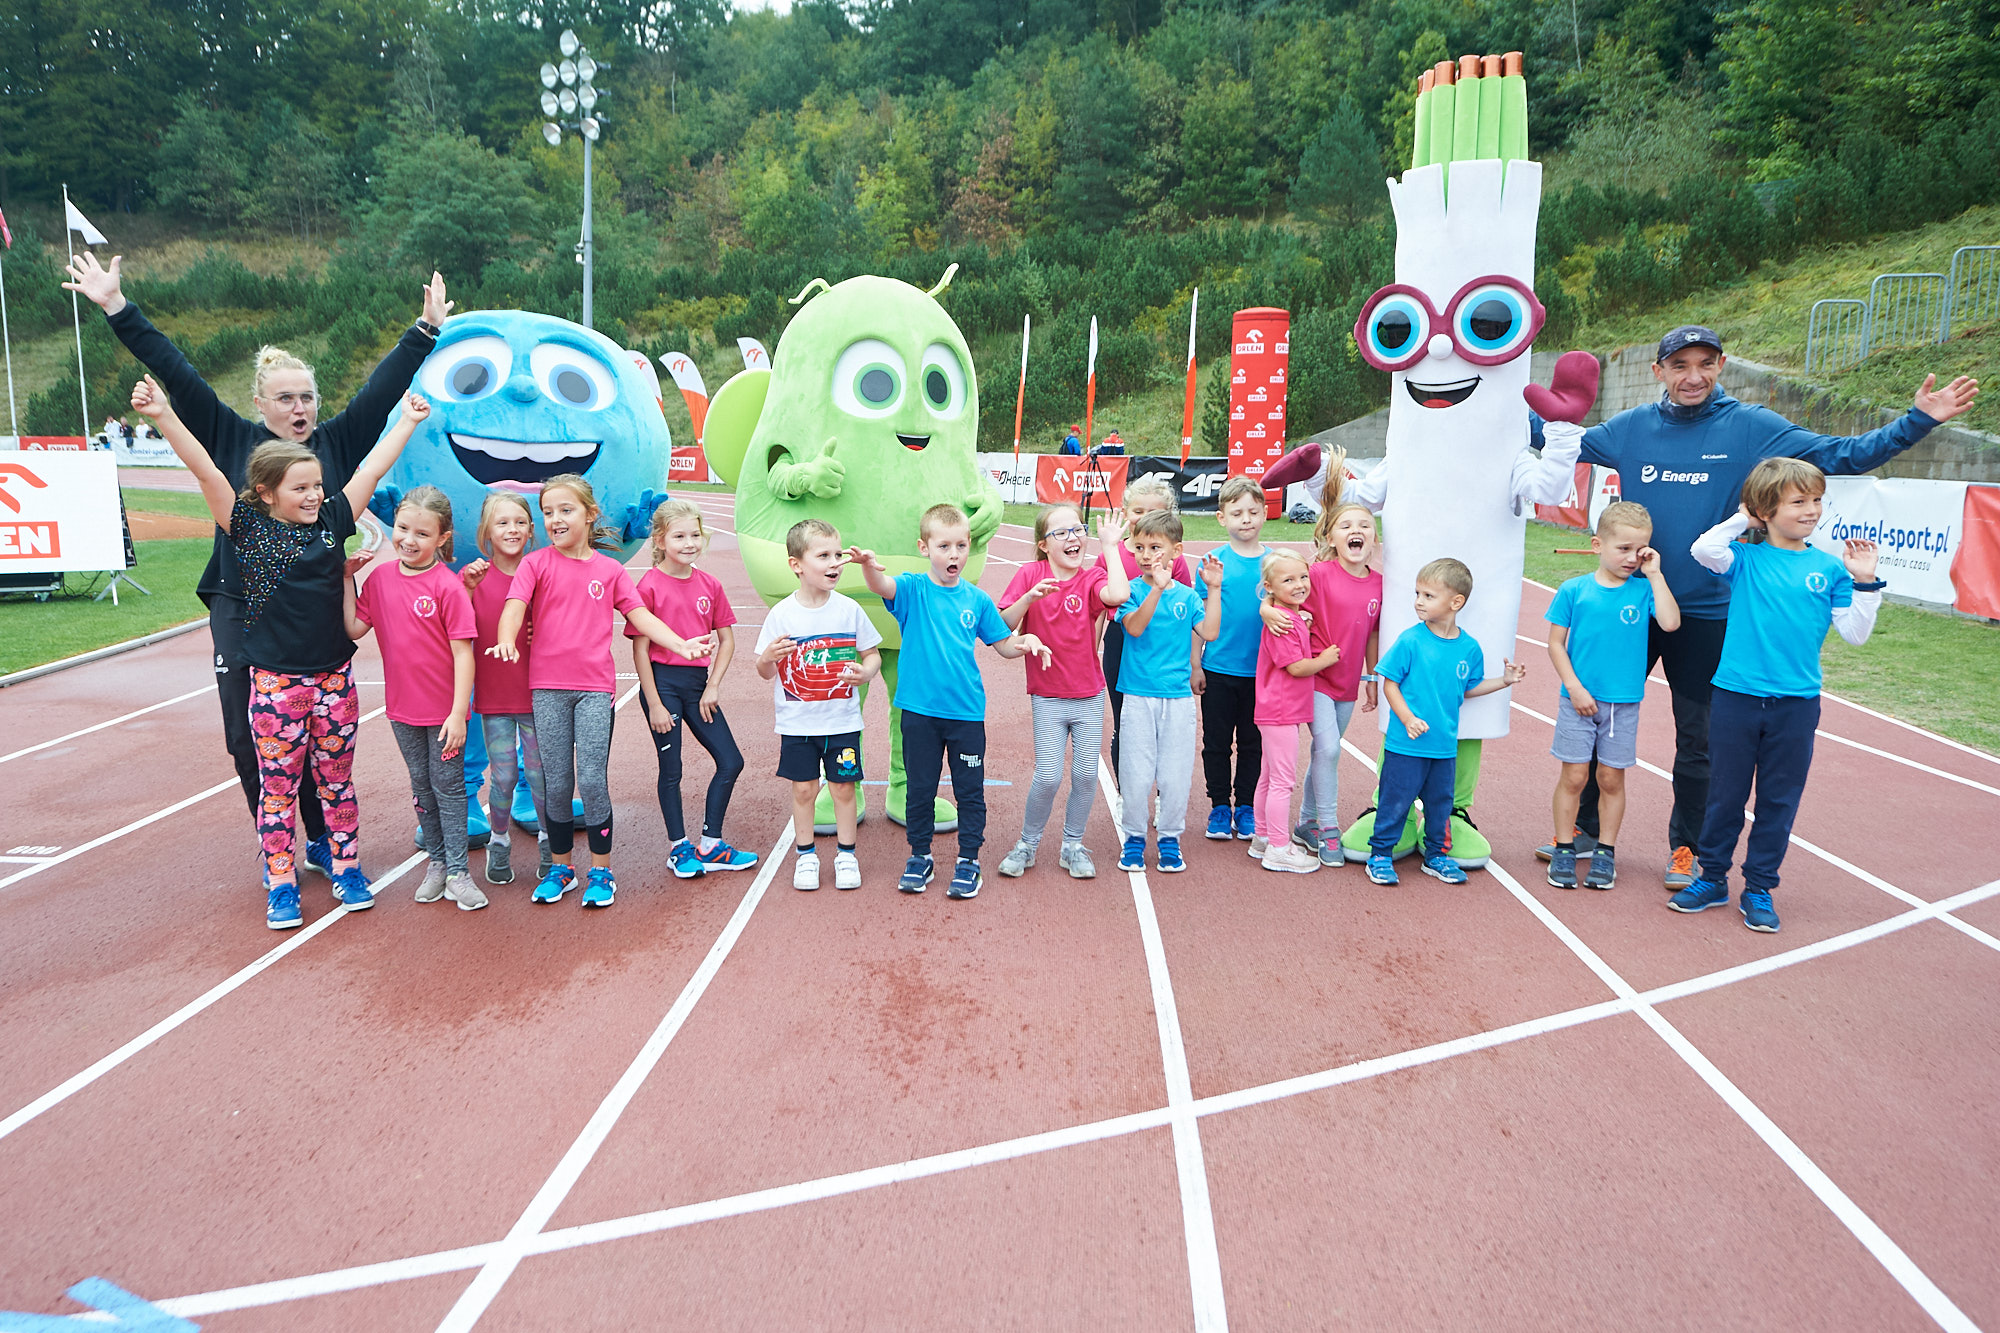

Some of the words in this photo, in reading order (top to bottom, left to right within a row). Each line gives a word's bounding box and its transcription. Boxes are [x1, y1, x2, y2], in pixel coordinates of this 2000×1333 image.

[670, 459, 694, 468] ORLEN
[1076, 475, 1108, 488] ORLEN
[1181, 473, 1228, 497] 4F
[1661, 470, 1709, 485] Energa
[1831, 516, 1951, 559] domtel-sport.pl
[1877, 554, 1908, 569] omiaru
